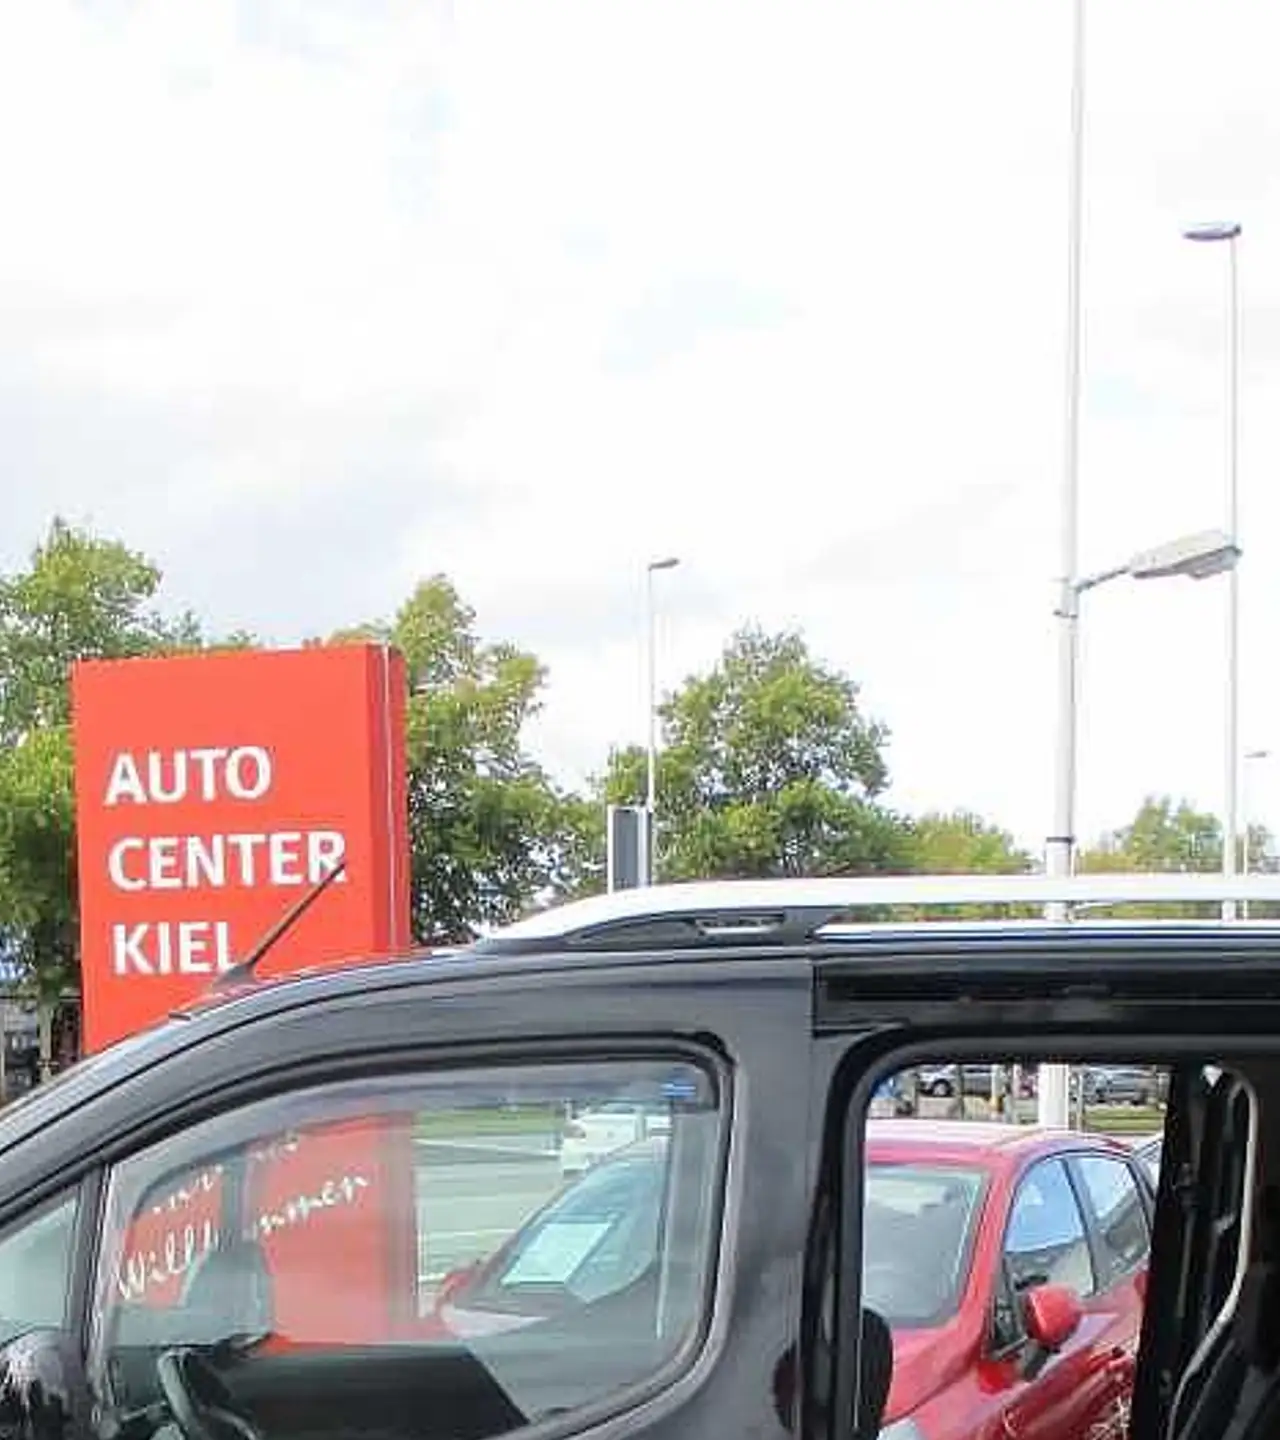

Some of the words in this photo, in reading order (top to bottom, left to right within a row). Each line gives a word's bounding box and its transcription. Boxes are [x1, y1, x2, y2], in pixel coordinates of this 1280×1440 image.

[104, 745, 272, 806] AUTO
[108, 830, 348, 891] CENTER
[112, 920, 239, 975] KIEL
